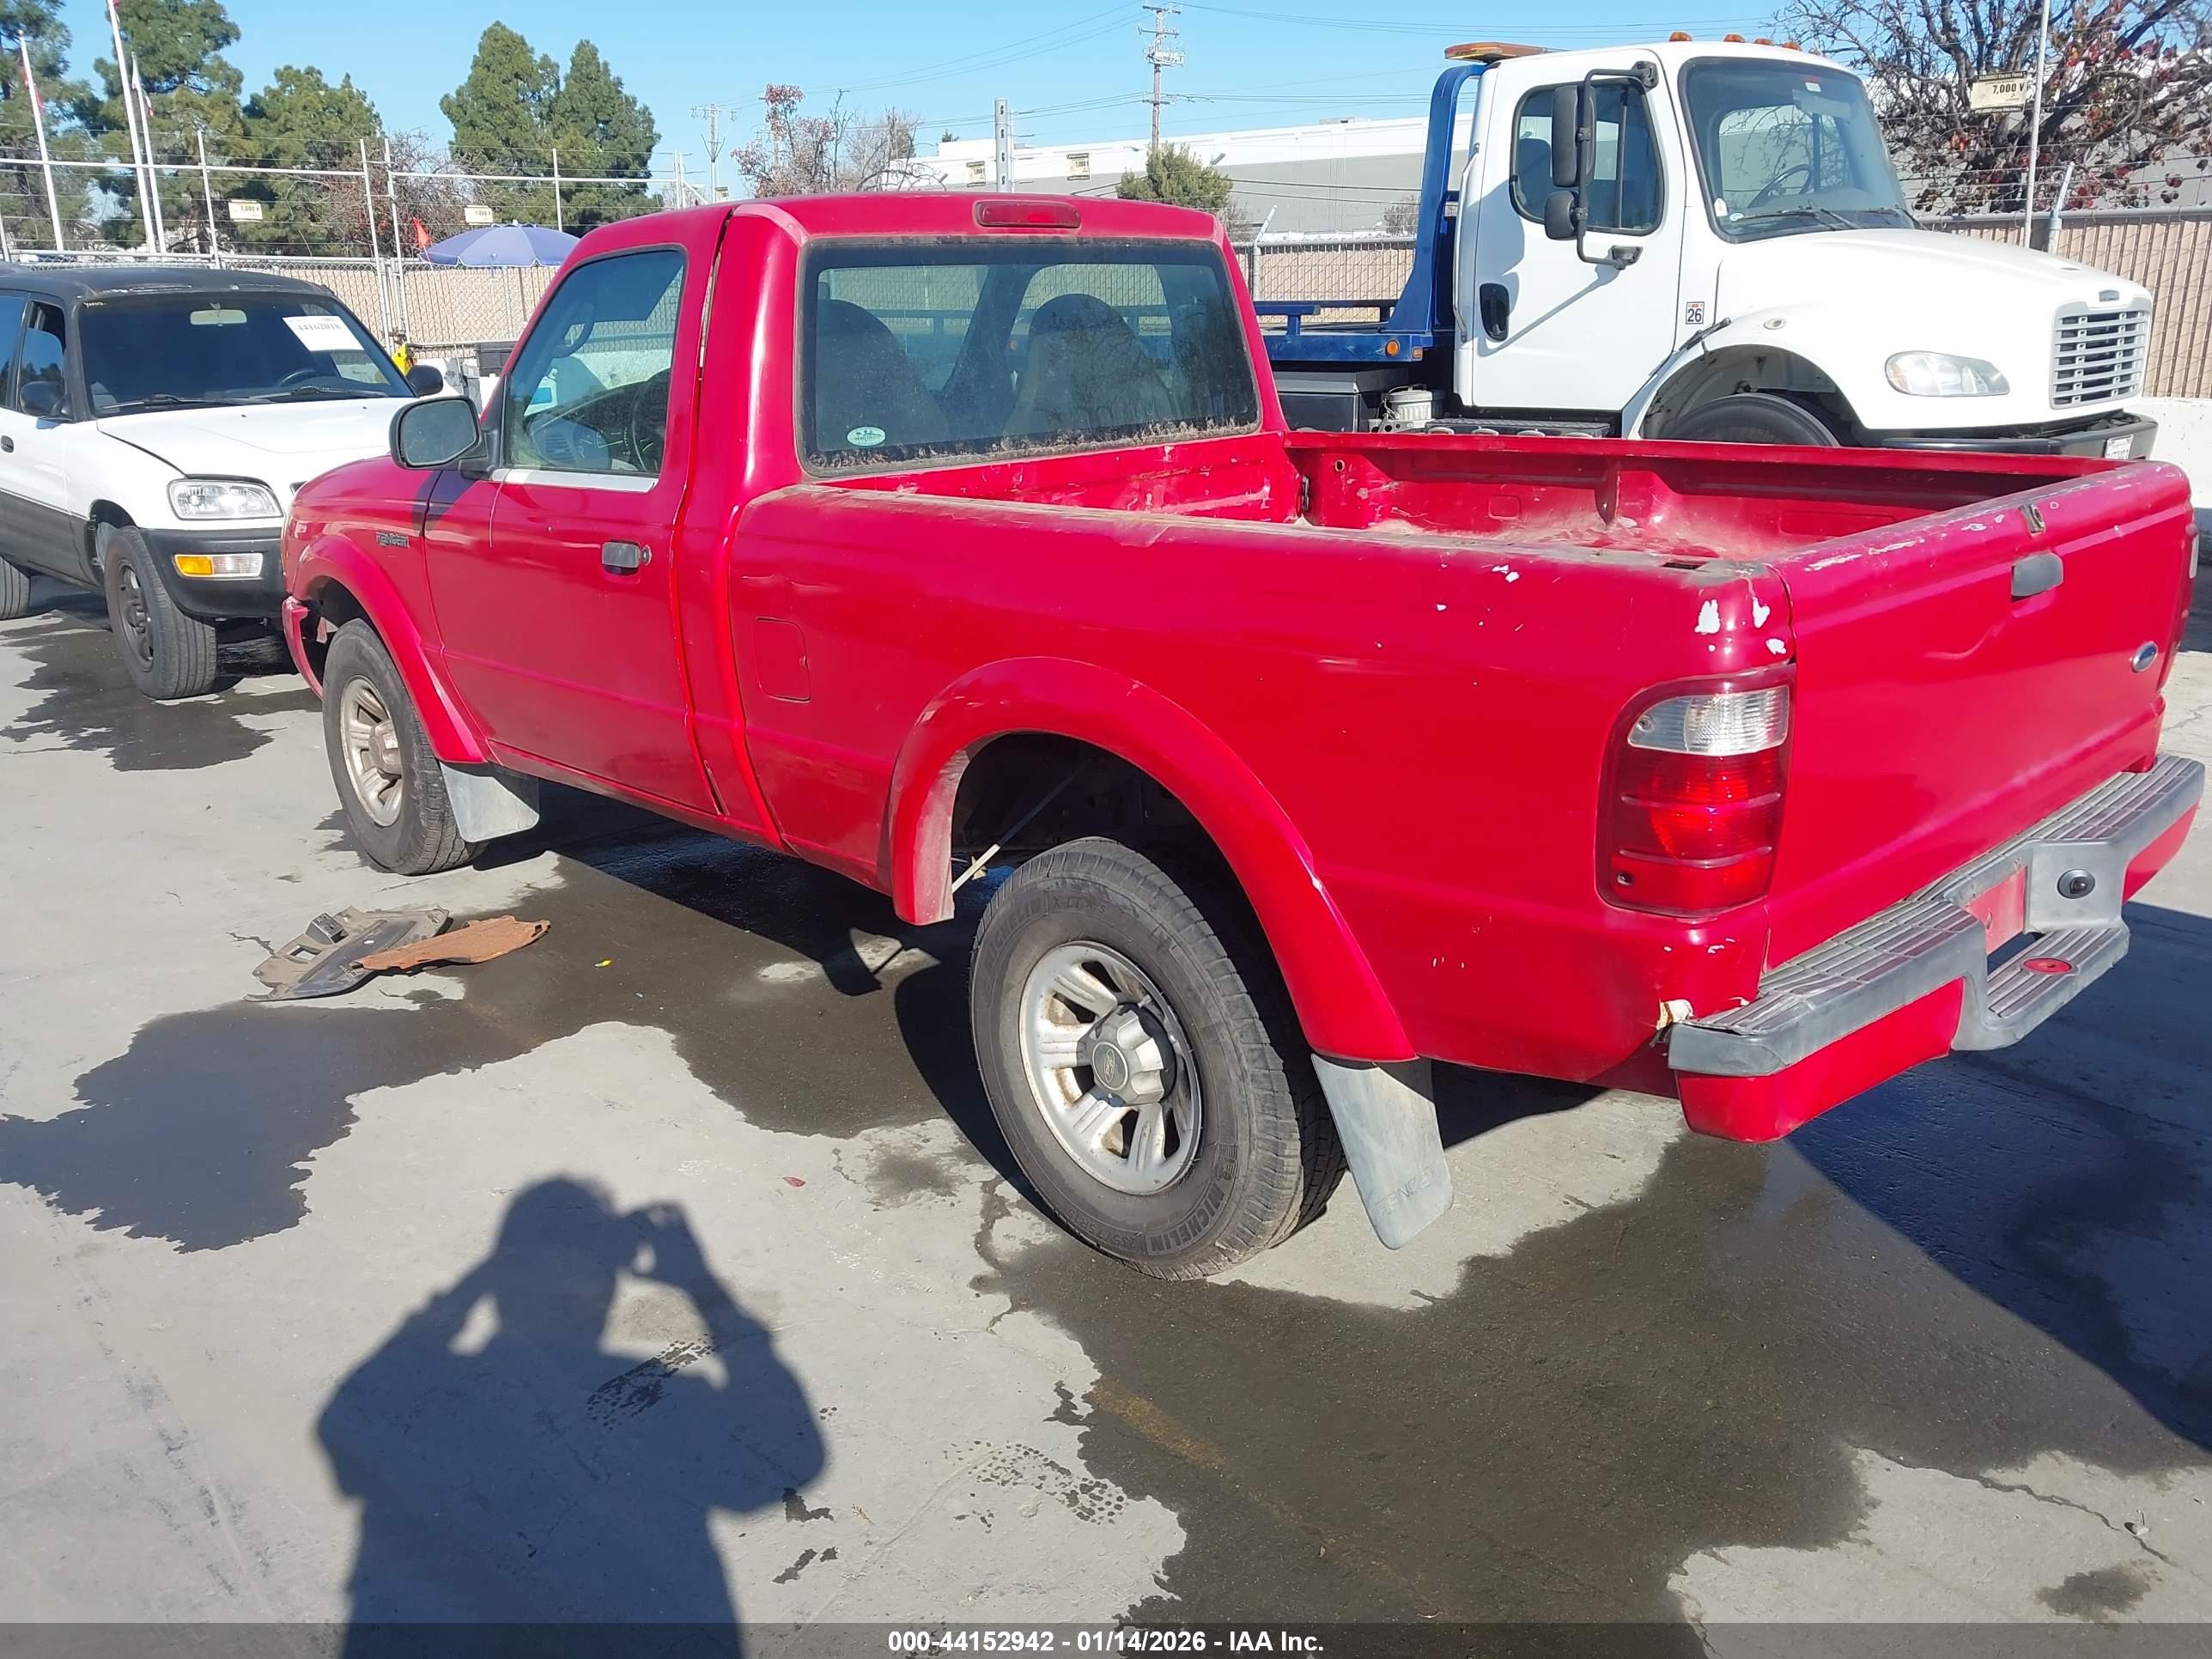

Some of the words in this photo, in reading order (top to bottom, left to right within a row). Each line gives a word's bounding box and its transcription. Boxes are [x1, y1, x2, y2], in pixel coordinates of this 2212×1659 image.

[1992, 82, 2017, 94] 7,000
[2019, 82, 2025, 92] V
[1687, 307, 1702, 323] 26
[1151, 1181, 1225, 1252] MICHELIN
